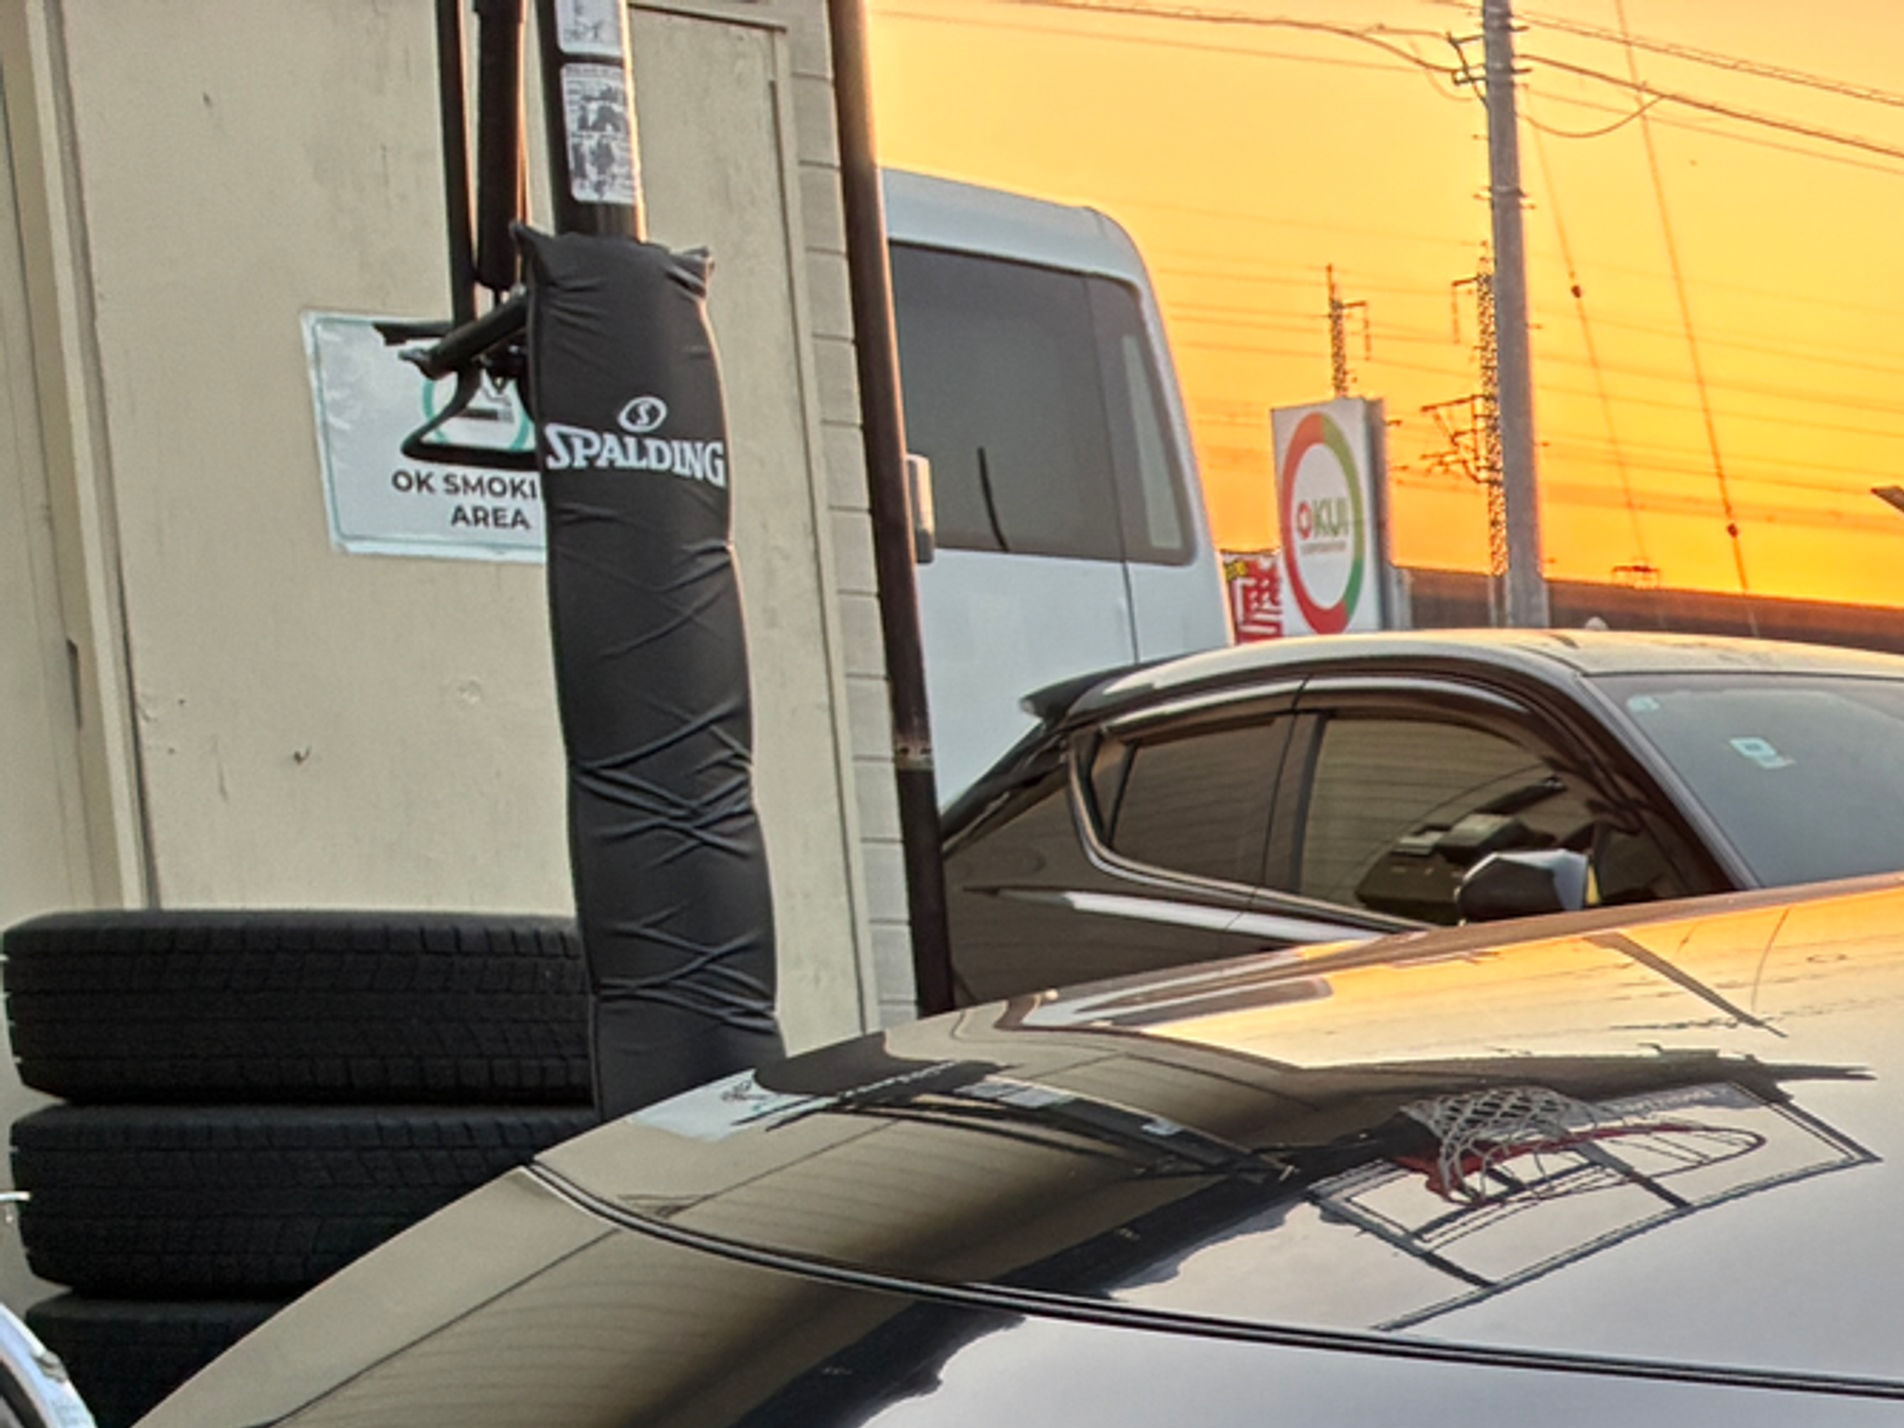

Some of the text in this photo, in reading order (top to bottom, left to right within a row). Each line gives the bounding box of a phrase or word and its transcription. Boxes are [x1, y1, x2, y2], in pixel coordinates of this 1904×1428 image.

[544, 421, 727, 489] SPALDING
[391, 469, 539, 500] OK SMOKI
[450, 504, 532, 530] AREA
